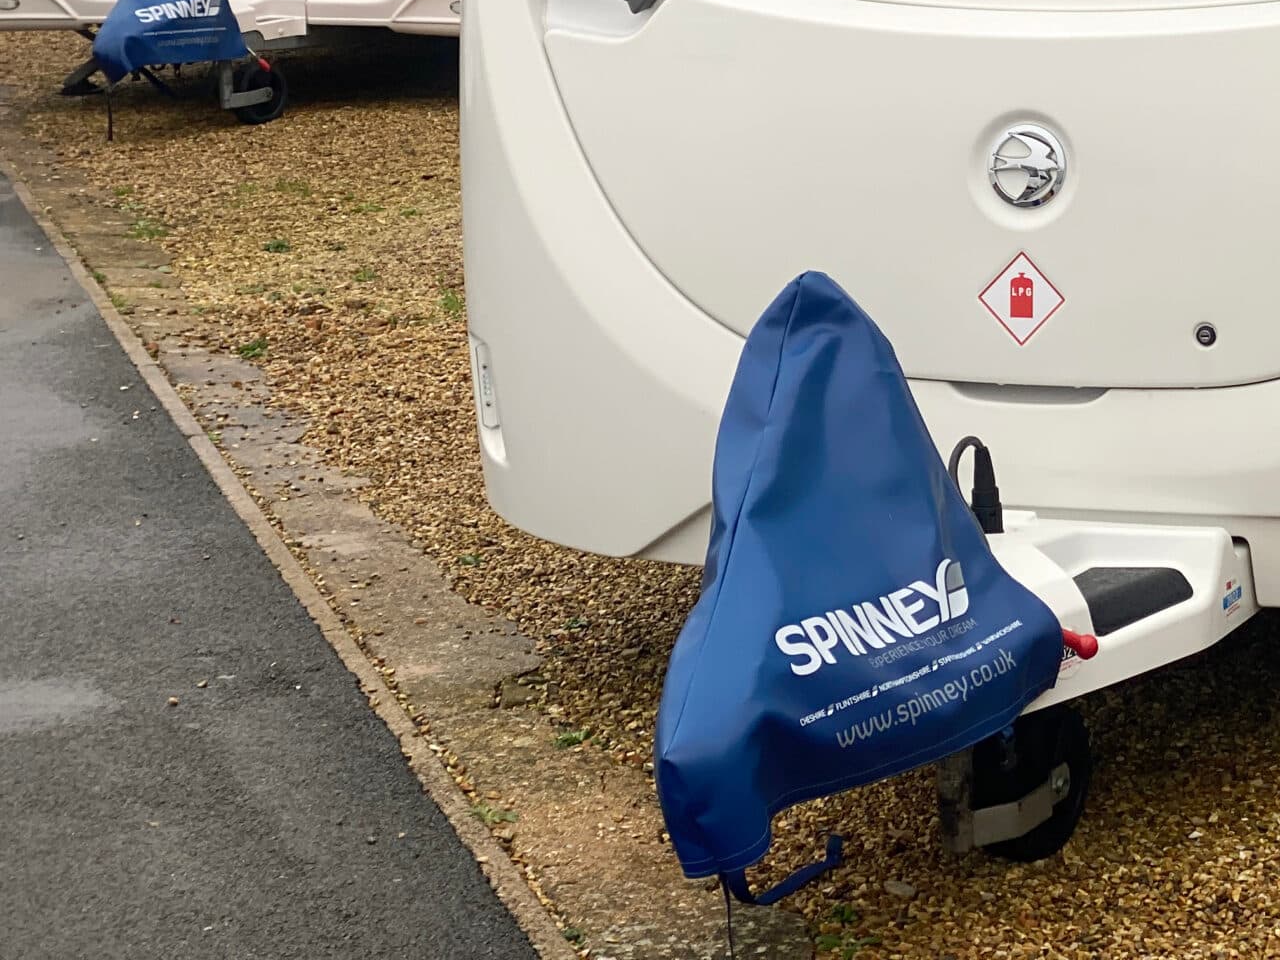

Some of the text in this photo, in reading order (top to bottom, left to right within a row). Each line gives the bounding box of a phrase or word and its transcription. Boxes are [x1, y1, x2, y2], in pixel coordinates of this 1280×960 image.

[1011, 287, 1032, 297] LPG
[775, 557, 968, 676] SPINNEY
[919, 629, 950, 649] YOUR
[947, 617, 979, 640] DREAM
[799, 708, 827, 728] CHESHIRE
[835, 689, 872, 712] FLINTSHIRE
[835, 647, 1017, 749] www.spinney.co.uk
